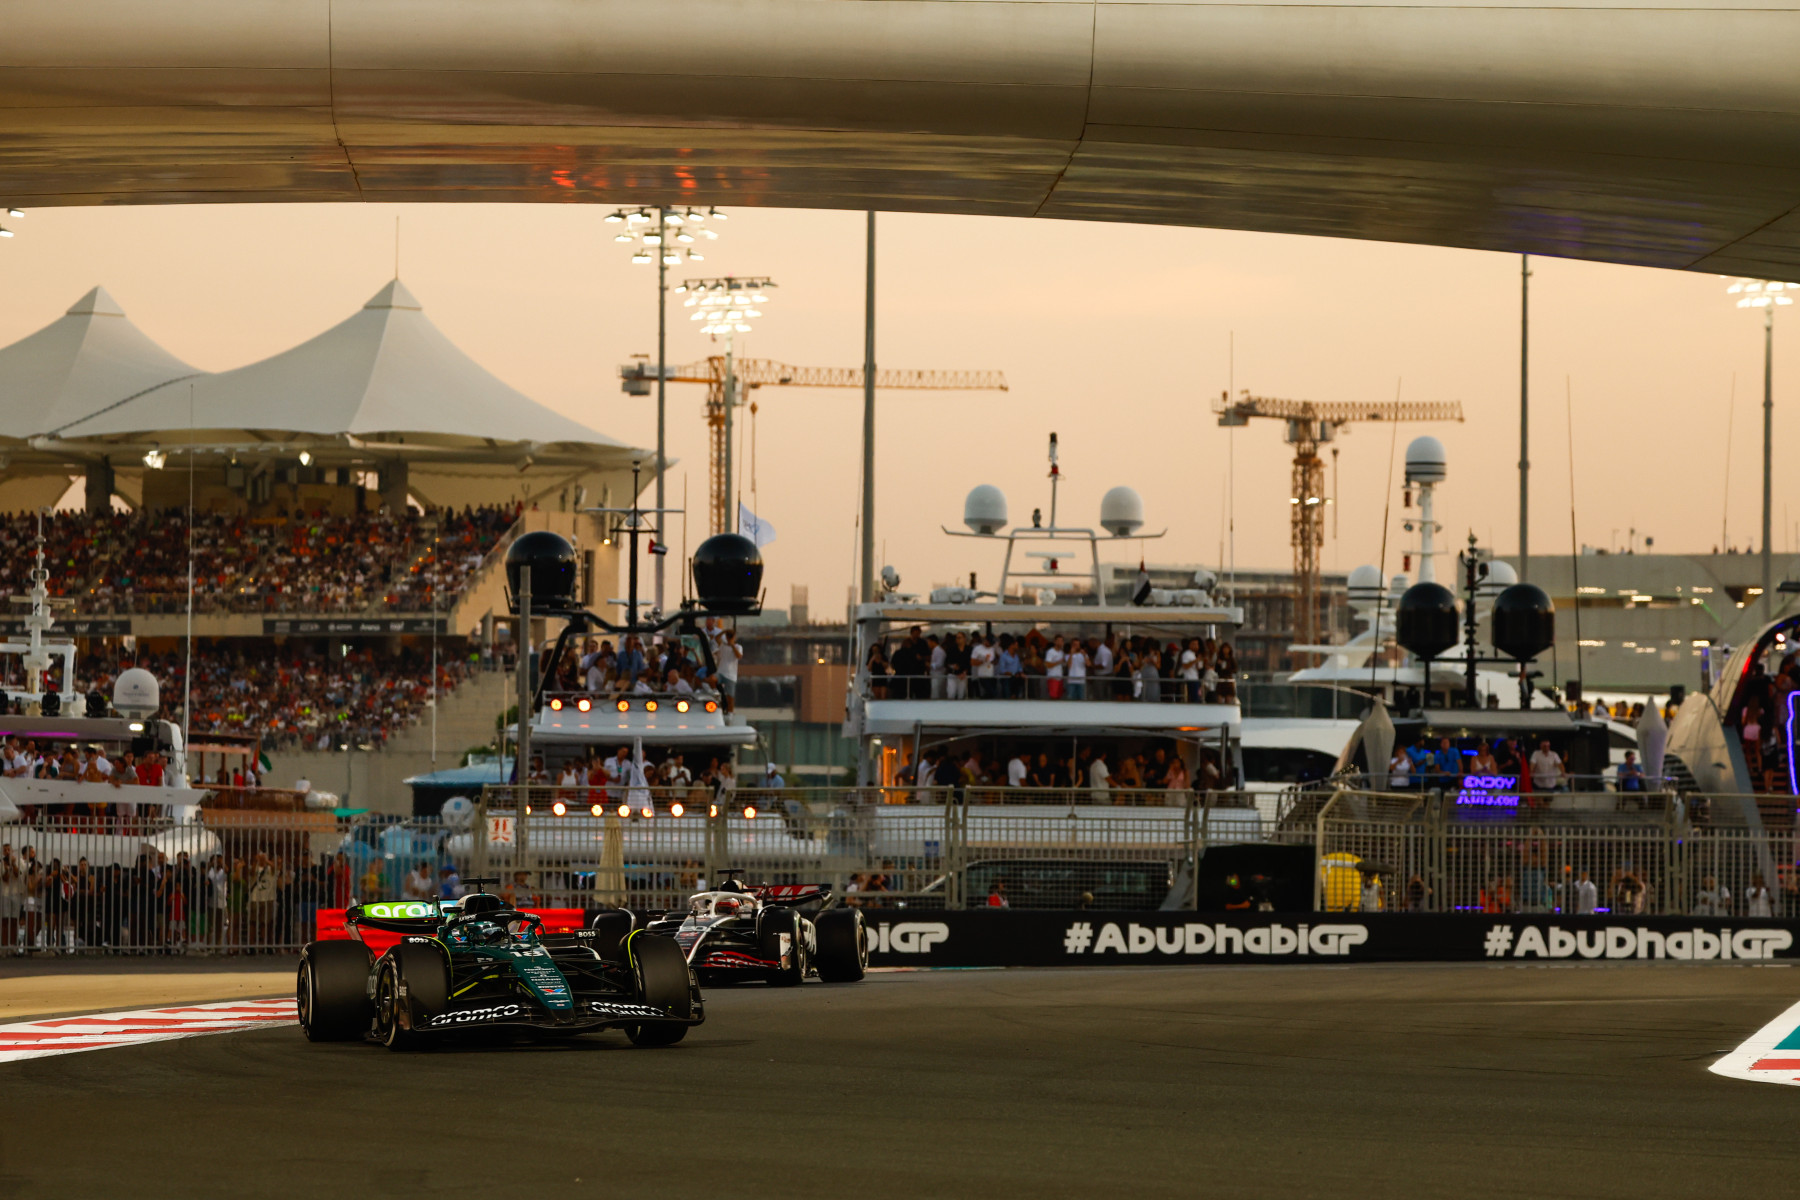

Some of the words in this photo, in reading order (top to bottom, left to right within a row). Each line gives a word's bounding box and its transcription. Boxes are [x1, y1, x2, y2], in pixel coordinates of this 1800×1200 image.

[1065, 923, 1368, 954] #AbuDhabiGP
[1484, 926, 1792, 959] #AbuDhabiGP
[431, 1004, 519, 1026] aramco
